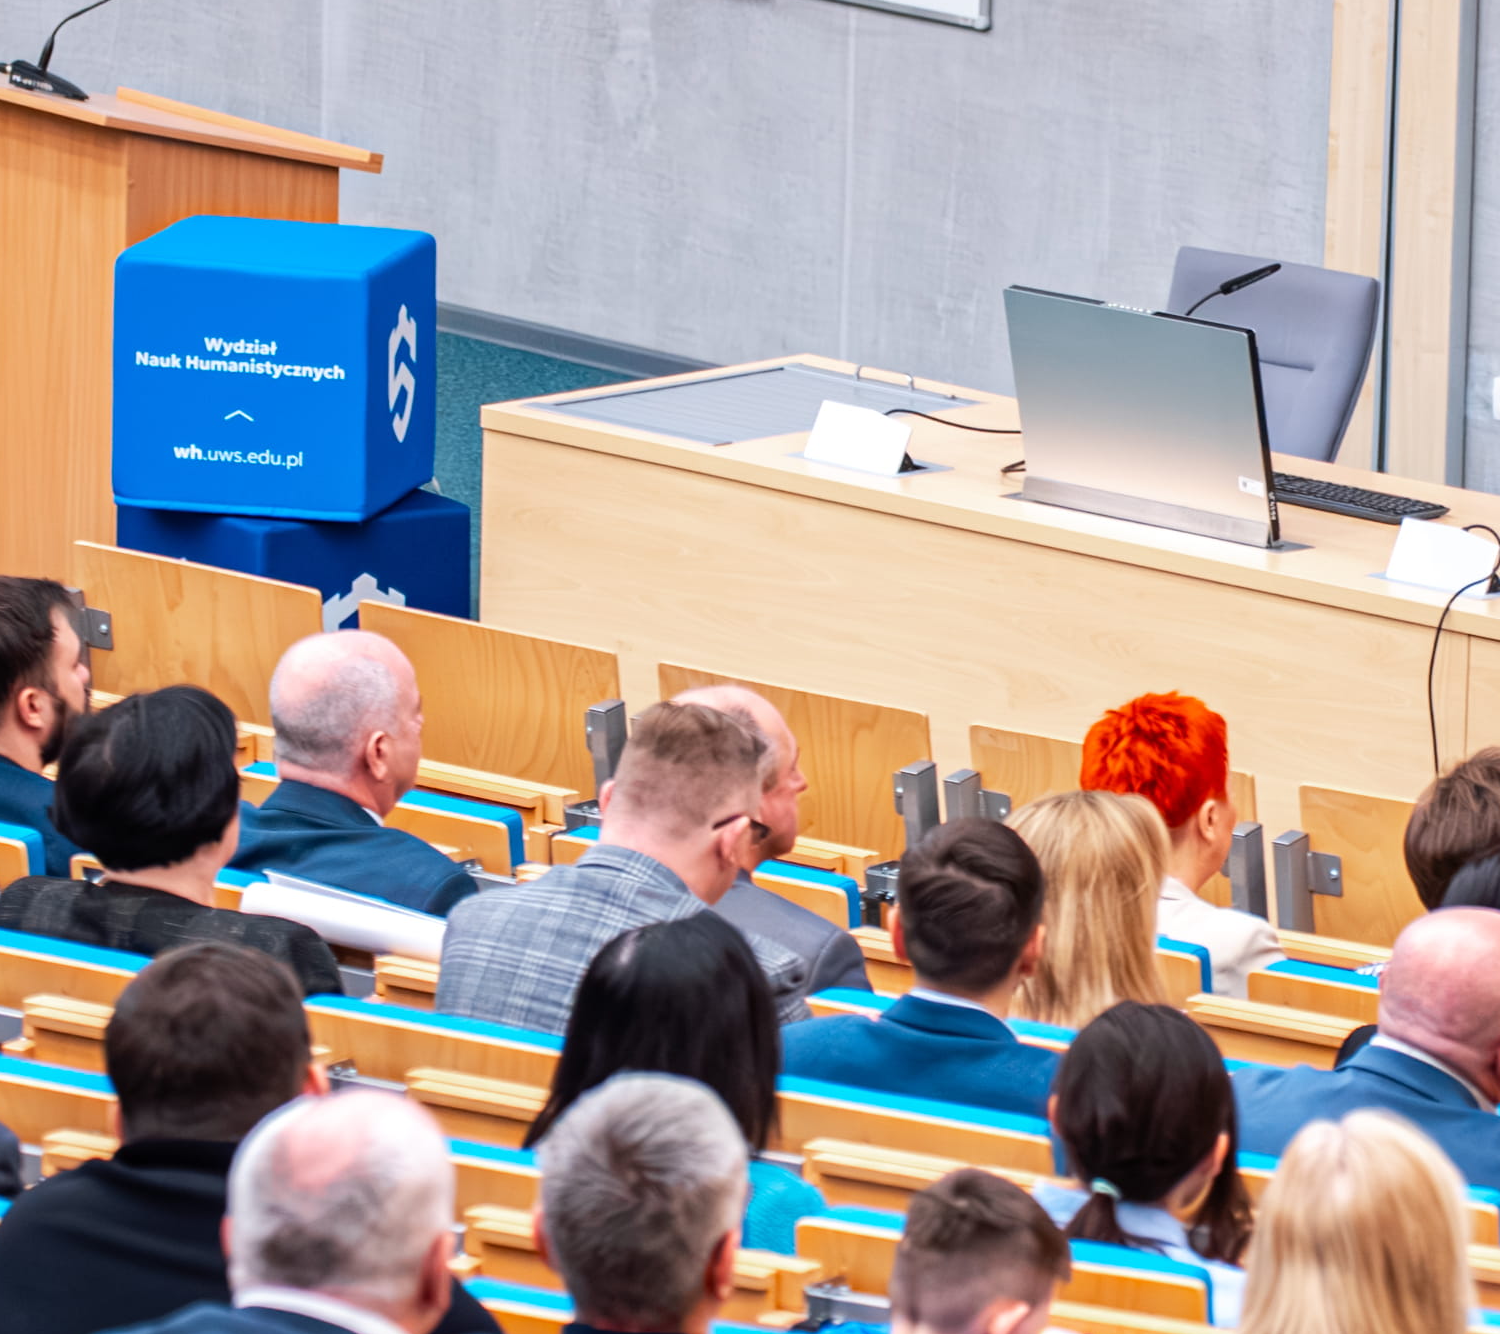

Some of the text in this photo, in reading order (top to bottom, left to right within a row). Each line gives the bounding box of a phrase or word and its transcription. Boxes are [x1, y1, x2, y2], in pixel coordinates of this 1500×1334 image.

[204, 337, 278, 356] Wydział
[135, 351, 346, 382] Nauk Humanistycznych
[173, 444, 304, 469] wh.uws.edu.pl
